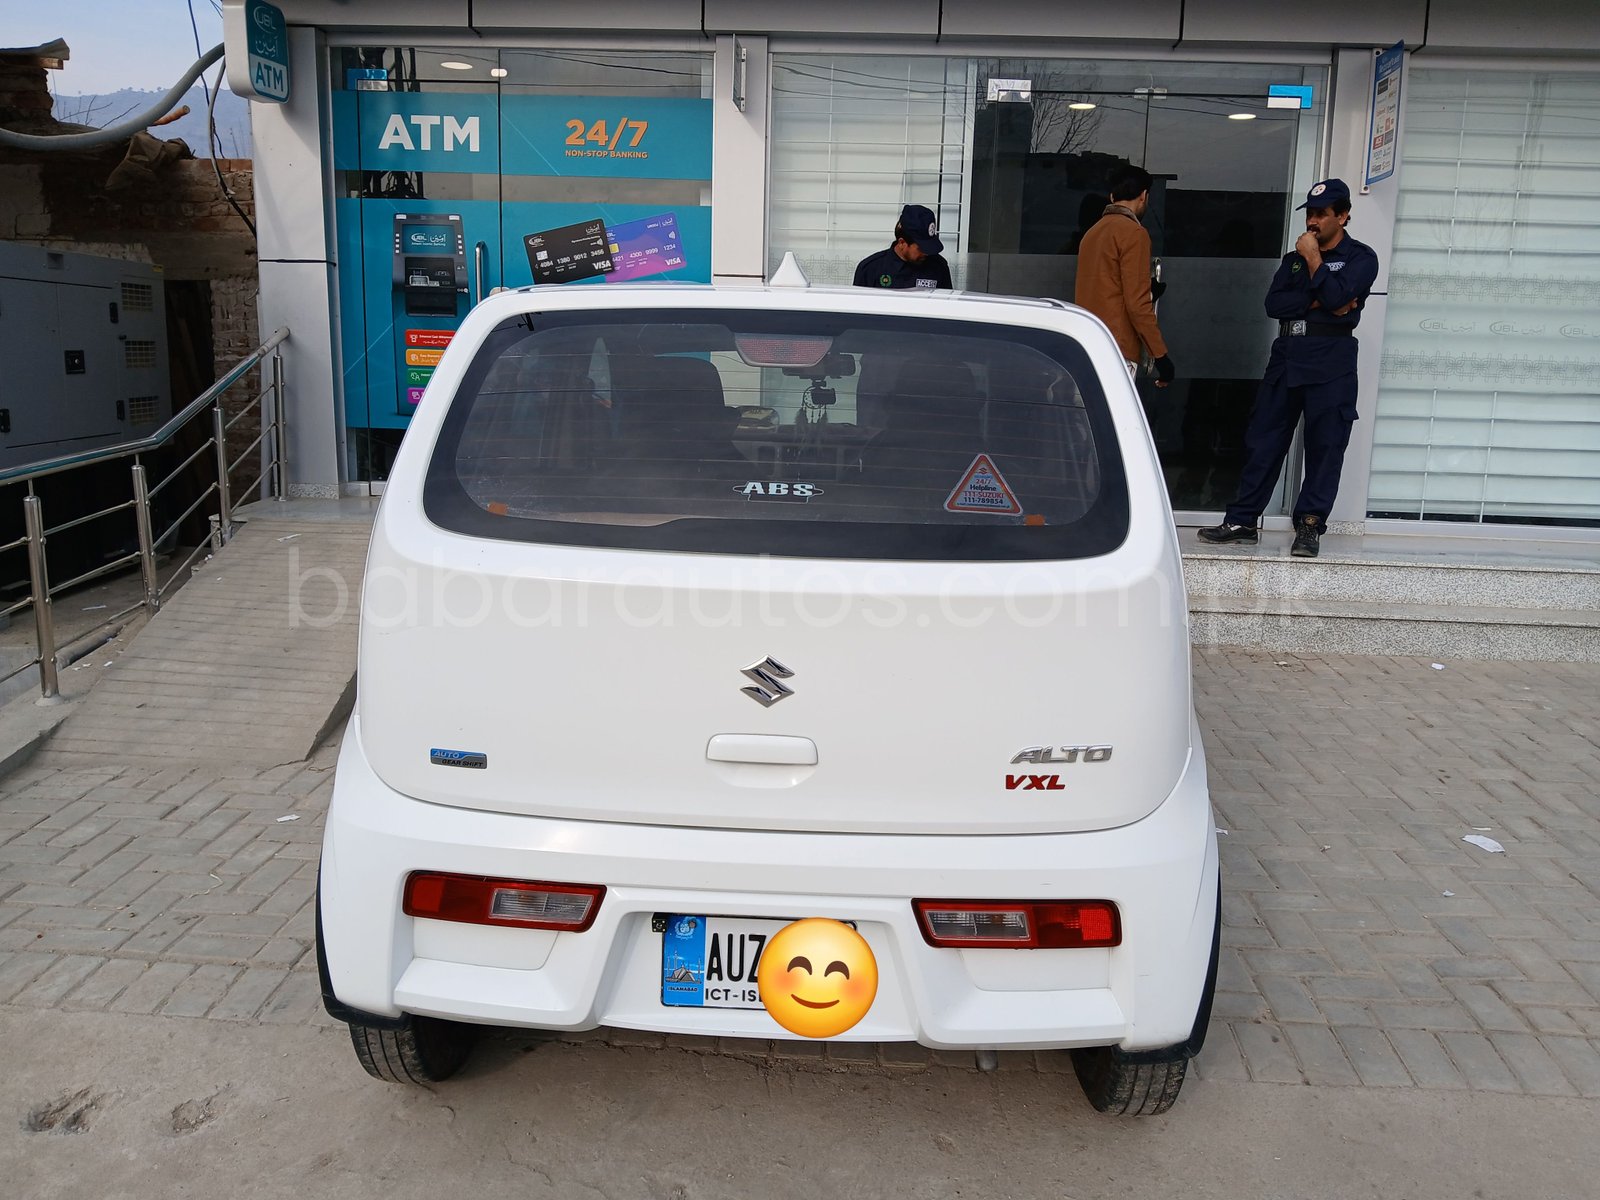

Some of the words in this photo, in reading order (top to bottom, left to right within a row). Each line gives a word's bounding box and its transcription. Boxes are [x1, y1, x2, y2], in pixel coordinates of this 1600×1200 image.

[255, 8, 276, 32] UBL
[256, 62, 284, 92] ATM
[378, 113, 480, 152] ATM
[565, 117, 649, 151] 24/7
[565, 150, 608, 158] NON-STOP
[610, 151, 649, 159] BANKING
[592, 260, 612, 270] VISA
[665, 257, 682, 266] VISA
[743, 482, 813, 496] ABS
[964, 491, 1004, 499] 111-SUZUKI
[970, 484, 997, 492] Helpline
[434, 750, 460, 759] AUTO
[1009, 744, 1113, 764] ALTO
[1005, 774, 1066, 790] VXL
[706, 932, 767, 983] AUZ
[705, 988, 763, 1002] ICT-IS
